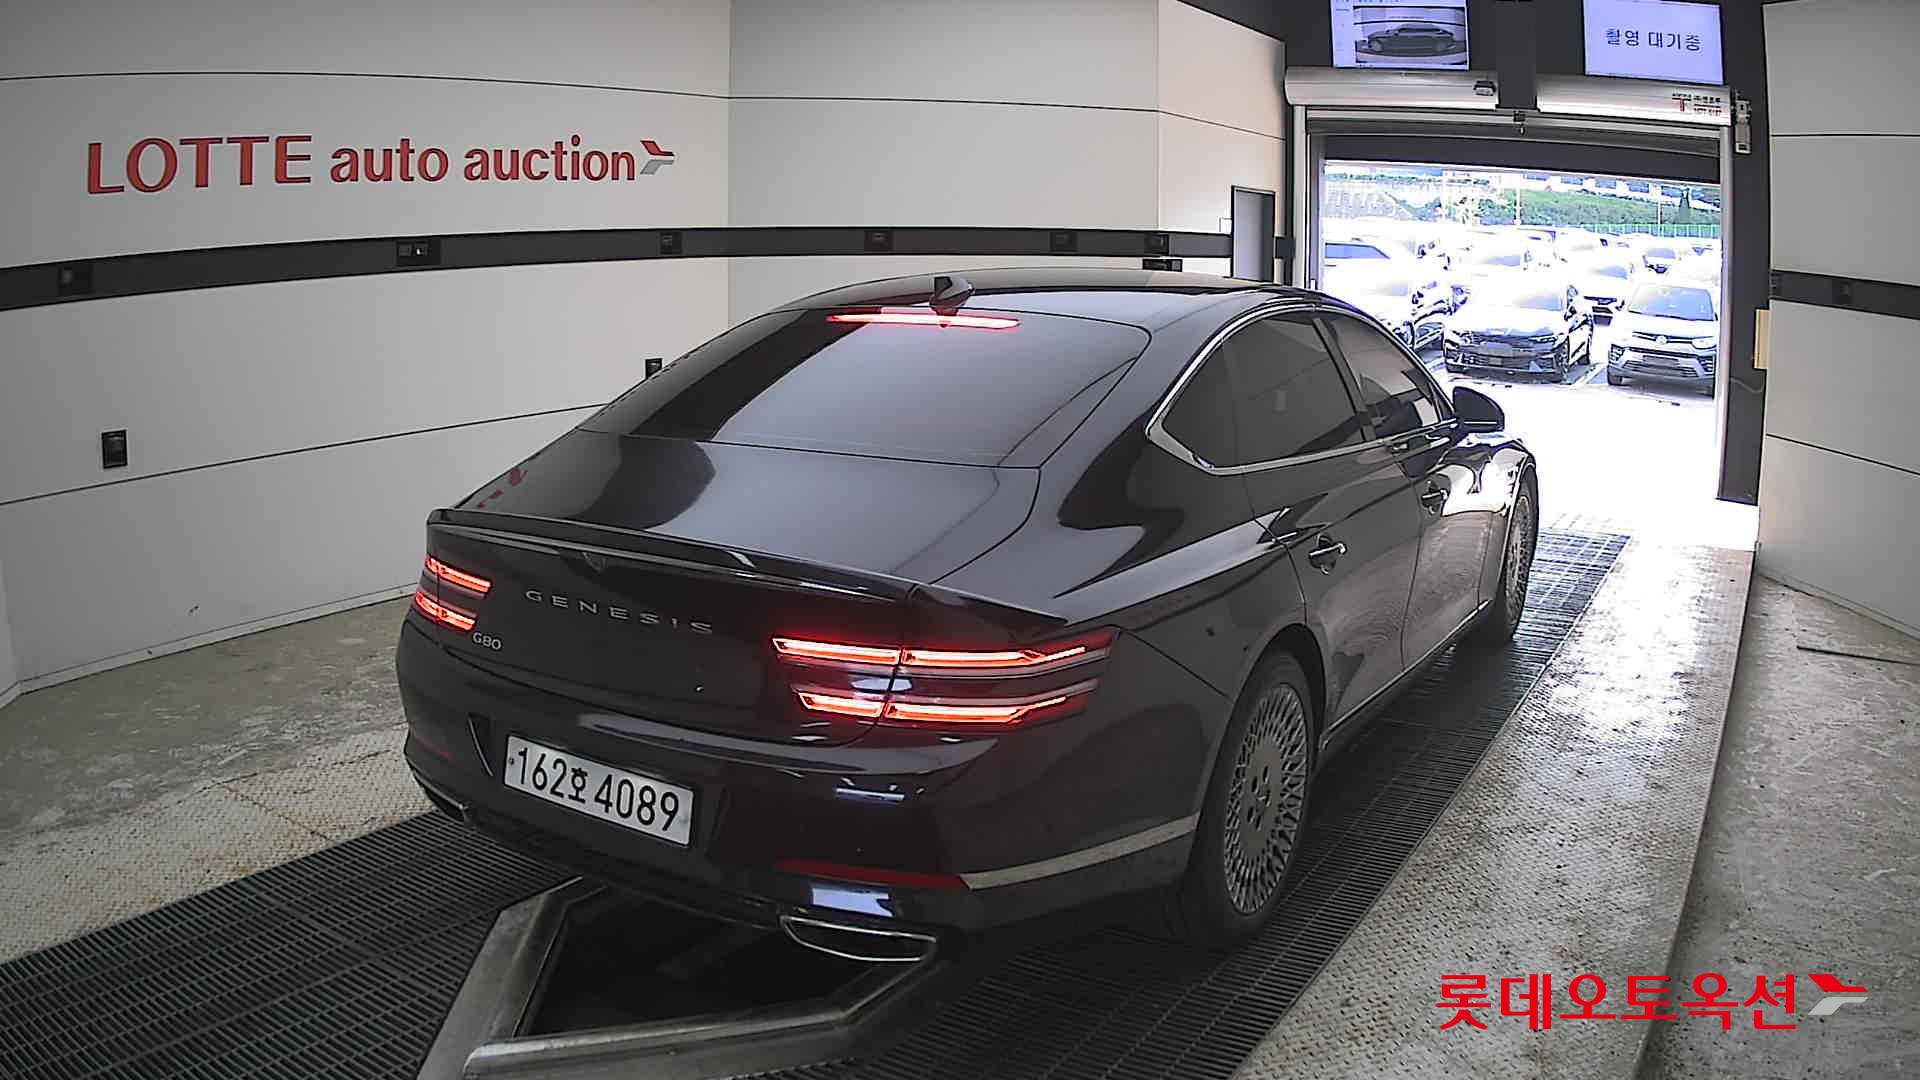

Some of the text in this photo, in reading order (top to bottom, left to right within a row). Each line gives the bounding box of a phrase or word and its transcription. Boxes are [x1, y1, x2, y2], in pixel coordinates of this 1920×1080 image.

[1606, 28, 1640, 47] 촬영
[86, 134, 637, 195] LOTTE auto auction
[525, 589, 713, 634] GENESIS
[472, 632, 502, 650] G80
